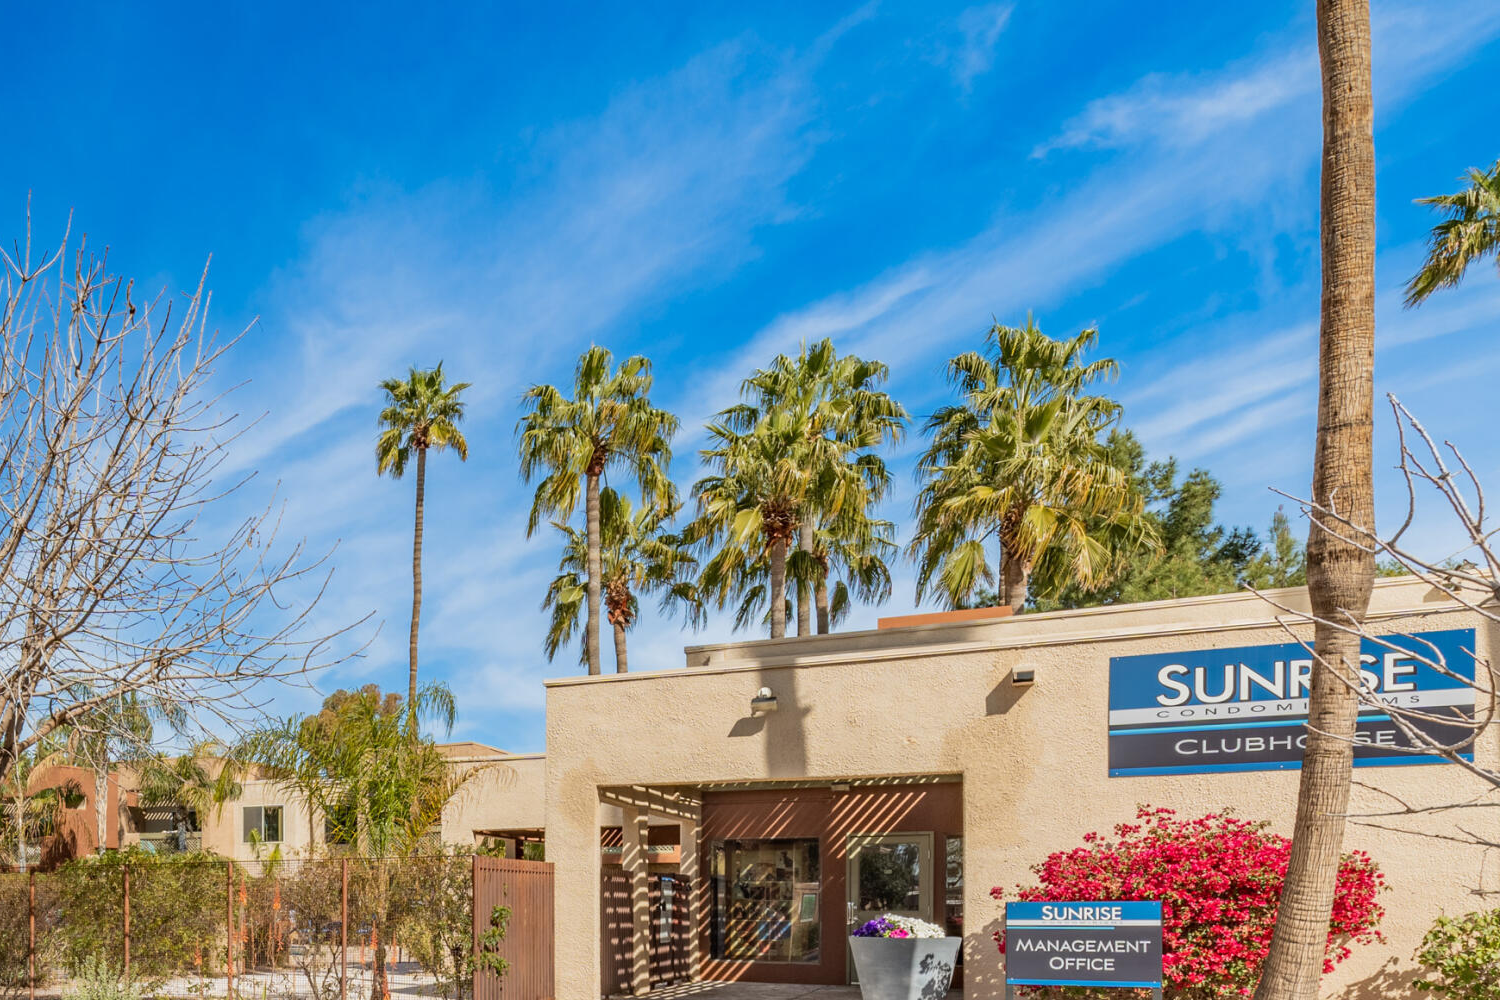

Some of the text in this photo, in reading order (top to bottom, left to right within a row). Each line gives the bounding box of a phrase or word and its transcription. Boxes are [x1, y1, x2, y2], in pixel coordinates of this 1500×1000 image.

[1156, 652, 1417, 706] SUNRSE
[1156, 695, 1420, 718] CONDOMIMS
[1175, 730, 1396, 755] CLUBHSE
[1041, 905, 1122, 920] SUNRISE
[1015, 938, 1151, 953] MANAGEMENT
[1049, 956, 1115, 971] OFFICE
